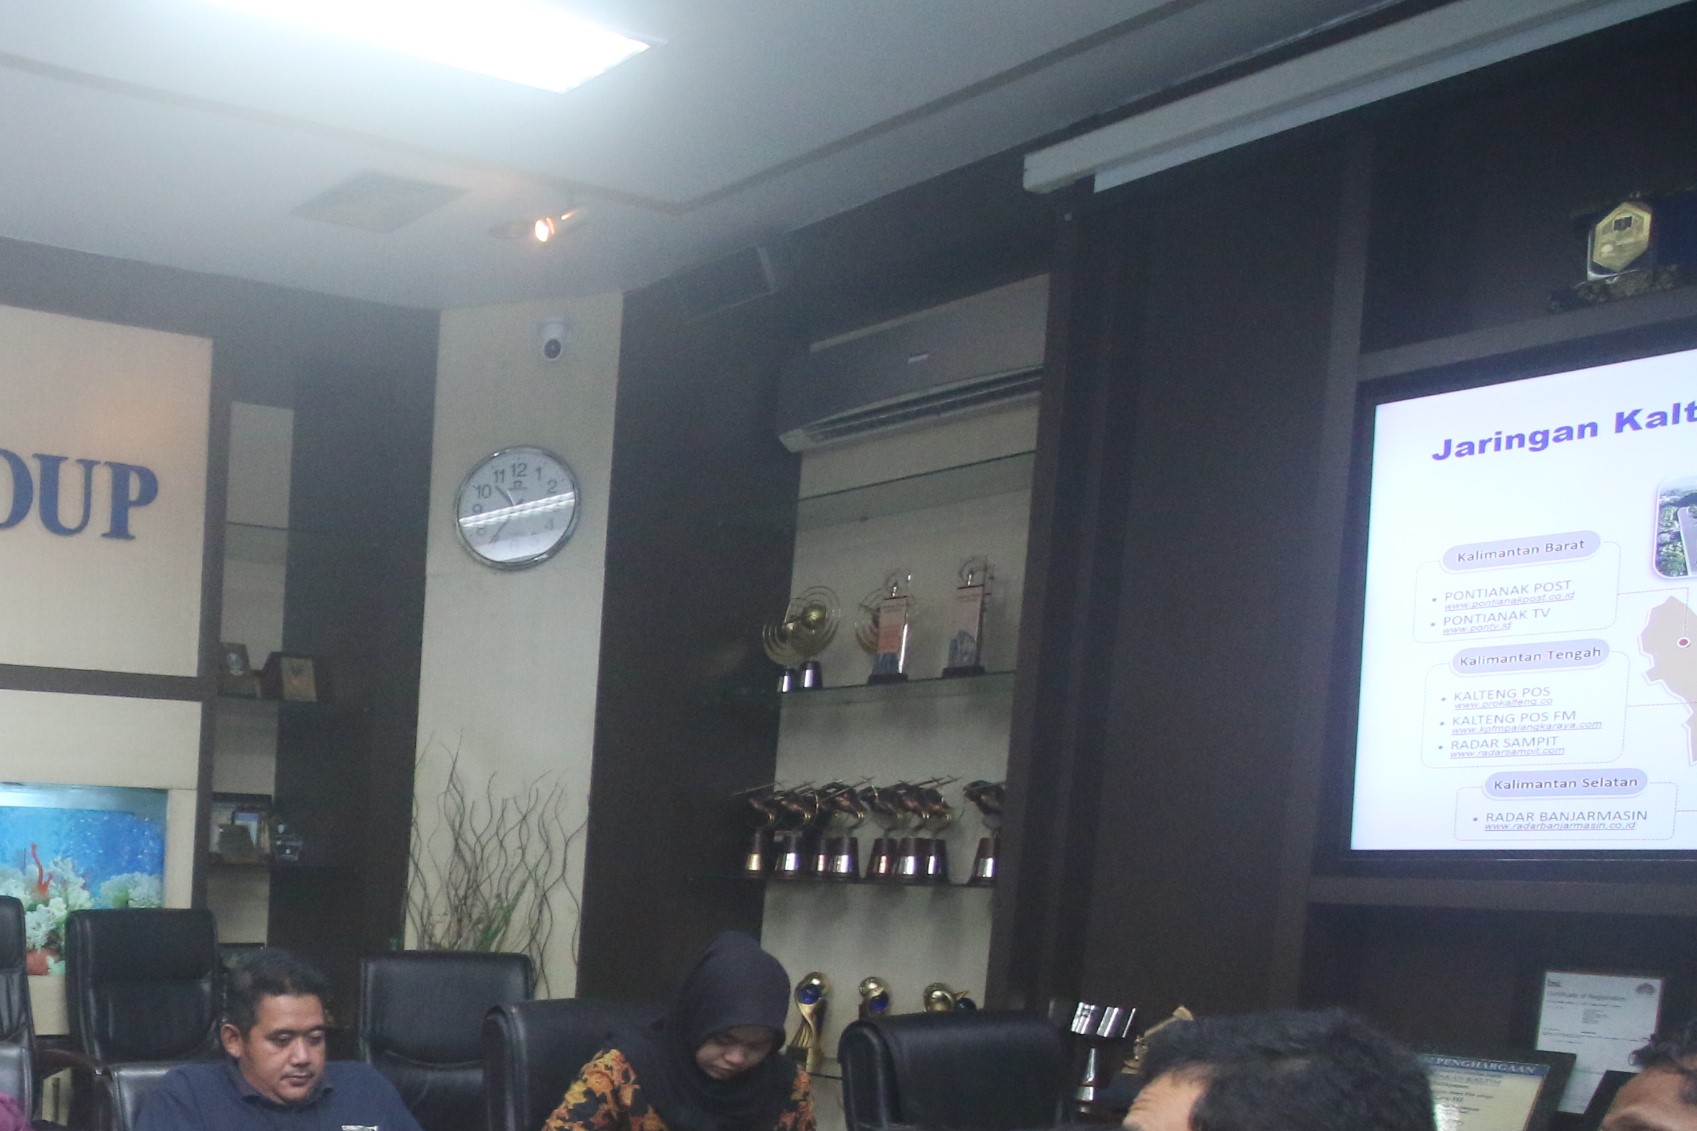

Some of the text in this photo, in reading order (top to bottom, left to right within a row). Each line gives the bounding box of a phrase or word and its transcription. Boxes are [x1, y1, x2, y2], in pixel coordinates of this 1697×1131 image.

[1432, 421, 1598, 460] Jaringan
[1457, 540, 1585, 562] Kalimantan Barat
[1444, 580, 1572, 600] PONTIANAK POST
[1443, 608, 1551, 625] PONTIANAK TV
[1460, 647, 1601, 666] Kalimantan Tengah
[1454, 687, 1551, 701] KALTENG POS
[1453, 710, 1576, 725] KALTENG POS FM
[1451, 736, 1559, 749] RADAR SAMPIT
[1494, 777, 1638, 790] Kalimantan Selatan
[1485, 810, 1648, 822] RADAR BANJARMASIN
[1436, 1058, 1536, 1073] PENGHARGAAN
